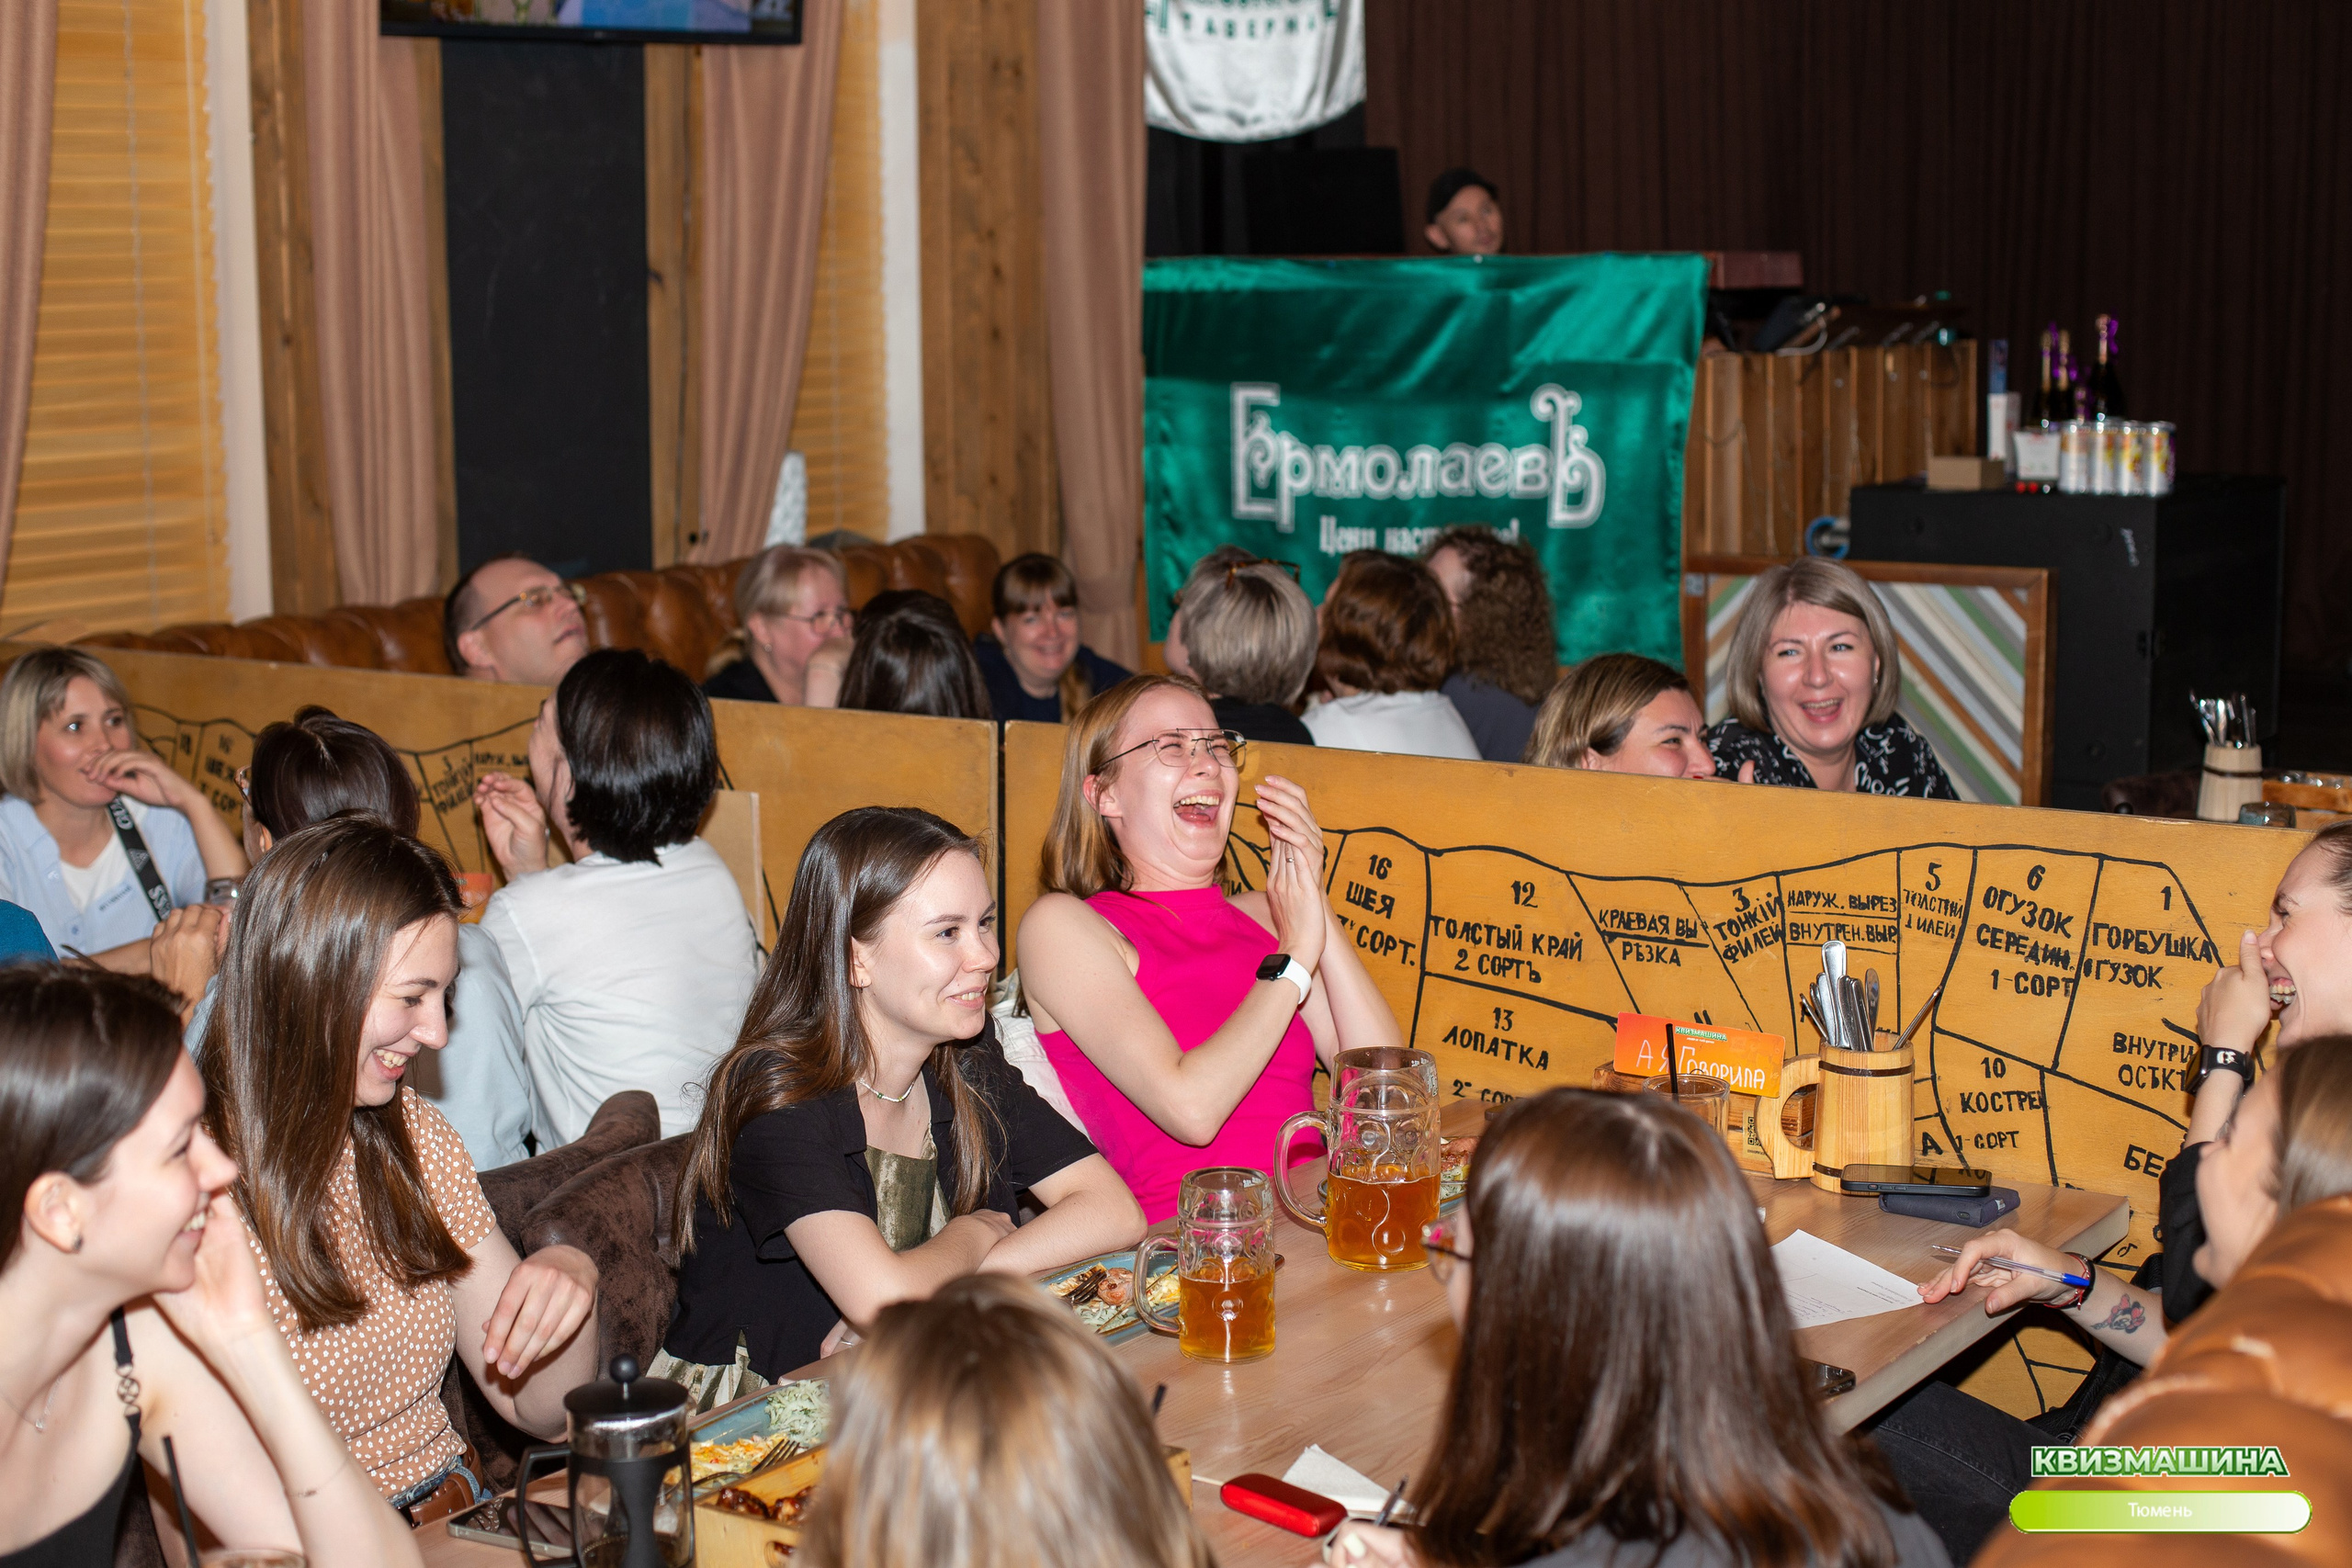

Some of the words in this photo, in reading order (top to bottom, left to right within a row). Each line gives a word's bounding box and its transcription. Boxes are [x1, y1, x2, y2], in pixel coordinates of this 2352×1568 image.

[1369, 854, 1393, 880] 16
[1926, 862, 1942, 891] 5
[2027, 864, 2046, 891] 6
[1346, 881, 1396, 919] ШЕЯ
[1510, 880, 1538, 908] 12
[1733, 887, 1750, 912] 3
[1787, 889, 1845, 910] НАРУЖ.
[1849, 890, 1897, 913] ВЫРЕЗ
[2161, 886, 2172, 911] 1
[1599, 909, 1670, 935] КРАЕВАЯ
[1982, 886, 2074, 939] ОГУЗОК
[1430, 916, 1522, 952] ТОЛСТЫЙ
[1532, 931, 1583, 962] КРАЙ
[2093, 922, 2213, 964] ГОРБУШКА
[1454, 948, 1470, 972] 2
[1477, 953, 1542, 984] СОРТЪ
[1493, 1007, 1514, 1032] 13
[1675, 1026, 1727, 1041] КВИЗМАШИНА
[1442, 1025, 1550, 1071] ЛОПАТКА
[1981, 1057, 2007, 1079] 10
